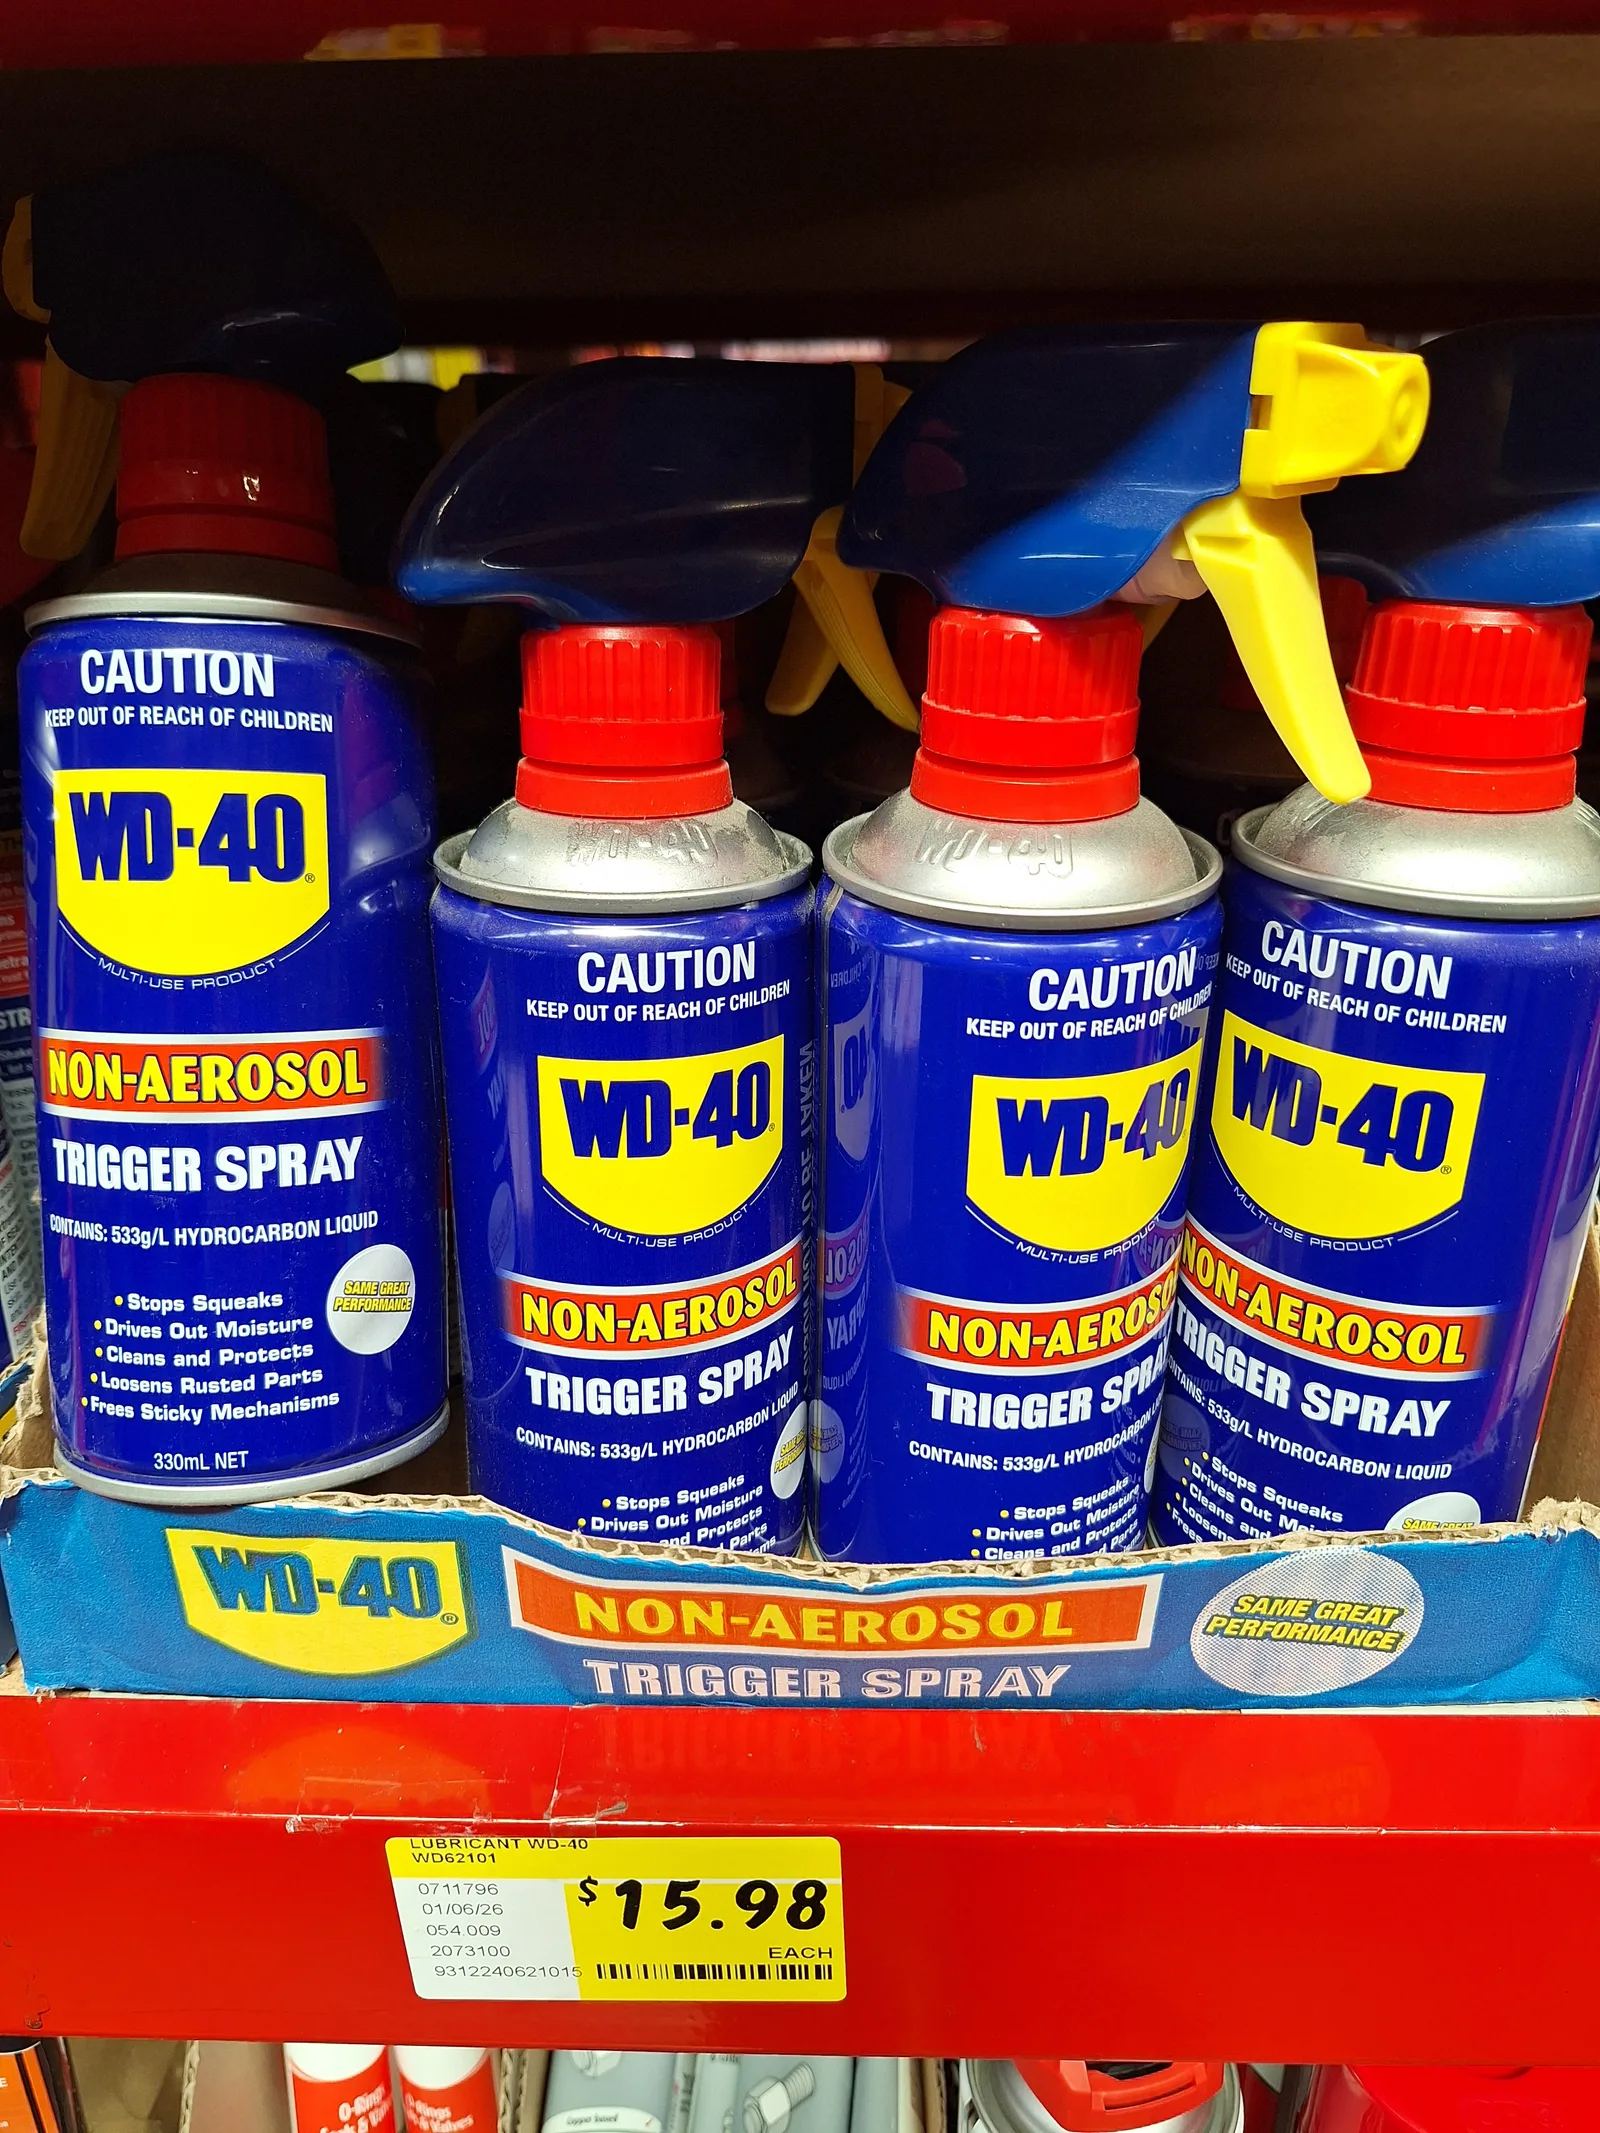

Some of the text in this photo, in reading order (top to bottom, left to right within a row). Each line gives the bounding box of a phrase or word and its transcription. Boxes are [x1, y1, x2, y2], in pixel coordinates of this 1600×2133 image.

[80, 649, 274, 697] CAUTION
[45, 706, 333, 733] KEEP OUT OF REACH OF CHILDREN
[68, 791, 305, 883] WD-40
[98, 957, 278, 991] MULTI-USE PRODUCT
[577, 940, 756, 994] CAUTION
[1029, 946, 1197, 1012] CAUTION
[1261, 920, 1452, 1000] CAUTION
[526, 979, 791, 1022] KEEP OUT OF REACH OF CHILDREN
[966, 980, 1212, 1040] KEEP OUT OF REACH OF CHILDREN
[1226, 953, 1507, 1033] KEEP OUT OF REACH OF CHILDREN
[48, 1048, 367, 1103] NON-AEROSOL
[559, 1060, 771, 1159] WD-40
[996, 1067, 1191, 1178] WD-40
[1232, 1035, 1453, 1172] WD-40
[53, 1138, 201, 1192] TRIGGER
[215, 1136, 363, 1191] SPRAY
[50, 1210, 379, 1249] CONTAINS: 533g/L HYDROCARBON LIQUID
[592, 1204, 749, 1248] MULTI-USE PRODUCT
[1015, 1242, 1098, 1263] MULTI-USE
[1103, 1213, 1160, 1259] PRODUCT
[1234, 1186, 1394, 1252] MULTI-USE PRODUCT
[127, 1291, 284, 1313] Stops Squeaks
[333, 1297, 412, 1312] PERFORMANCE
[344, 1280, 410, 1296] SAME GREAT
[521, 1254, 797, 1344] NON-AEROSOL
[1182, 1228, 1466, 1365] NON-AEROSOL
[104, 1315, 314, 1340] Drives Out Moisture
[106, 1342, 314, 1367] Cleans and Protects
[525, 1325, 795, 1416] TRIGGER SPRAY
[1176, 1296, 1451, 1438] TRIGGER SPRAY
[100, 1367, 323, 1395] Loosens Rusted Parts
[90, 1392, 340, 1425] Frees Sticky Mechanisms
[515, 1426, 596, 1458] CONTAINS:
[600, 1441, 658, 1462] 533g/L
[662, 1406, 770, 1457] HYDROCARBON
[771, 1380, 799, 1422] LIQUID
[926, 1382, 1093, 1430] TRIGGER
[153, 1451, 249, 1471] 330mL NET
[909, 1440, 998, 1471] CONTAINS:
[1003, 1454, 1060, 1472] 533g/L
[1064, 1407, 1152, 1465] HYDROCARBON
[1207, 1395, 1253, 1439] 533g/L
[1257, 1428, 1390, 1478] HYDROCARBON
[1394, 1460, 1452, 1480] LIQUID
[591, 1484, 763, 1532] Drives Out Moisture
[615, 1474, 745, 1512] Stops Squeaks
[986, 1484, 1139, 1541] Drives Out Moisture
[1014, 1476, 1129, 1520] Stops Squeaks
[1190, 1483, 1234, 1525] Cleans
[1240, 1521, 1271, 1540] and
[1191, 1462, 1273, 1522] Drives Out
[1211, 1456, 1257, 1493] Stops
[1263, 1486, 1343, 1523] Squeaks
[697, 1505, 763, 1541] Protects
[730, 1522, 768, 1550] Parts
[985, 1547, 1044, 1560] Cleans
[1051, 1537, 1080, 1555] and
[1085, 1504, 1137, 1545] Protects
[1111, 1519, 1138, 1550] Parts
[192, 1545, 441, 1618] WD-40
[575, 1592, 1073, 1644] NON-AEROSOL
[1205, 1615, 1406, 1652] PERFORMANCE
[1233, 1594, 1407, 1628] SAME GREAT
[582, 1658, 1071, 1698] TRIGGER SPRAY
[410, 1838, 588, 1850] LUBRICANT WD-40
[412, 1852, 496, 1864] WD62101
[418, 1883, 499, 1895] 0711796
[422, 1903, 504, 1916] 01/06/26
[426, 1925, 501, 1936] 054.009
[430, 1945, 510, 1957] 2073100
[768, 1947, 833, 1959] EACH
[434, 1965, 582, 1978] 9312240621015
